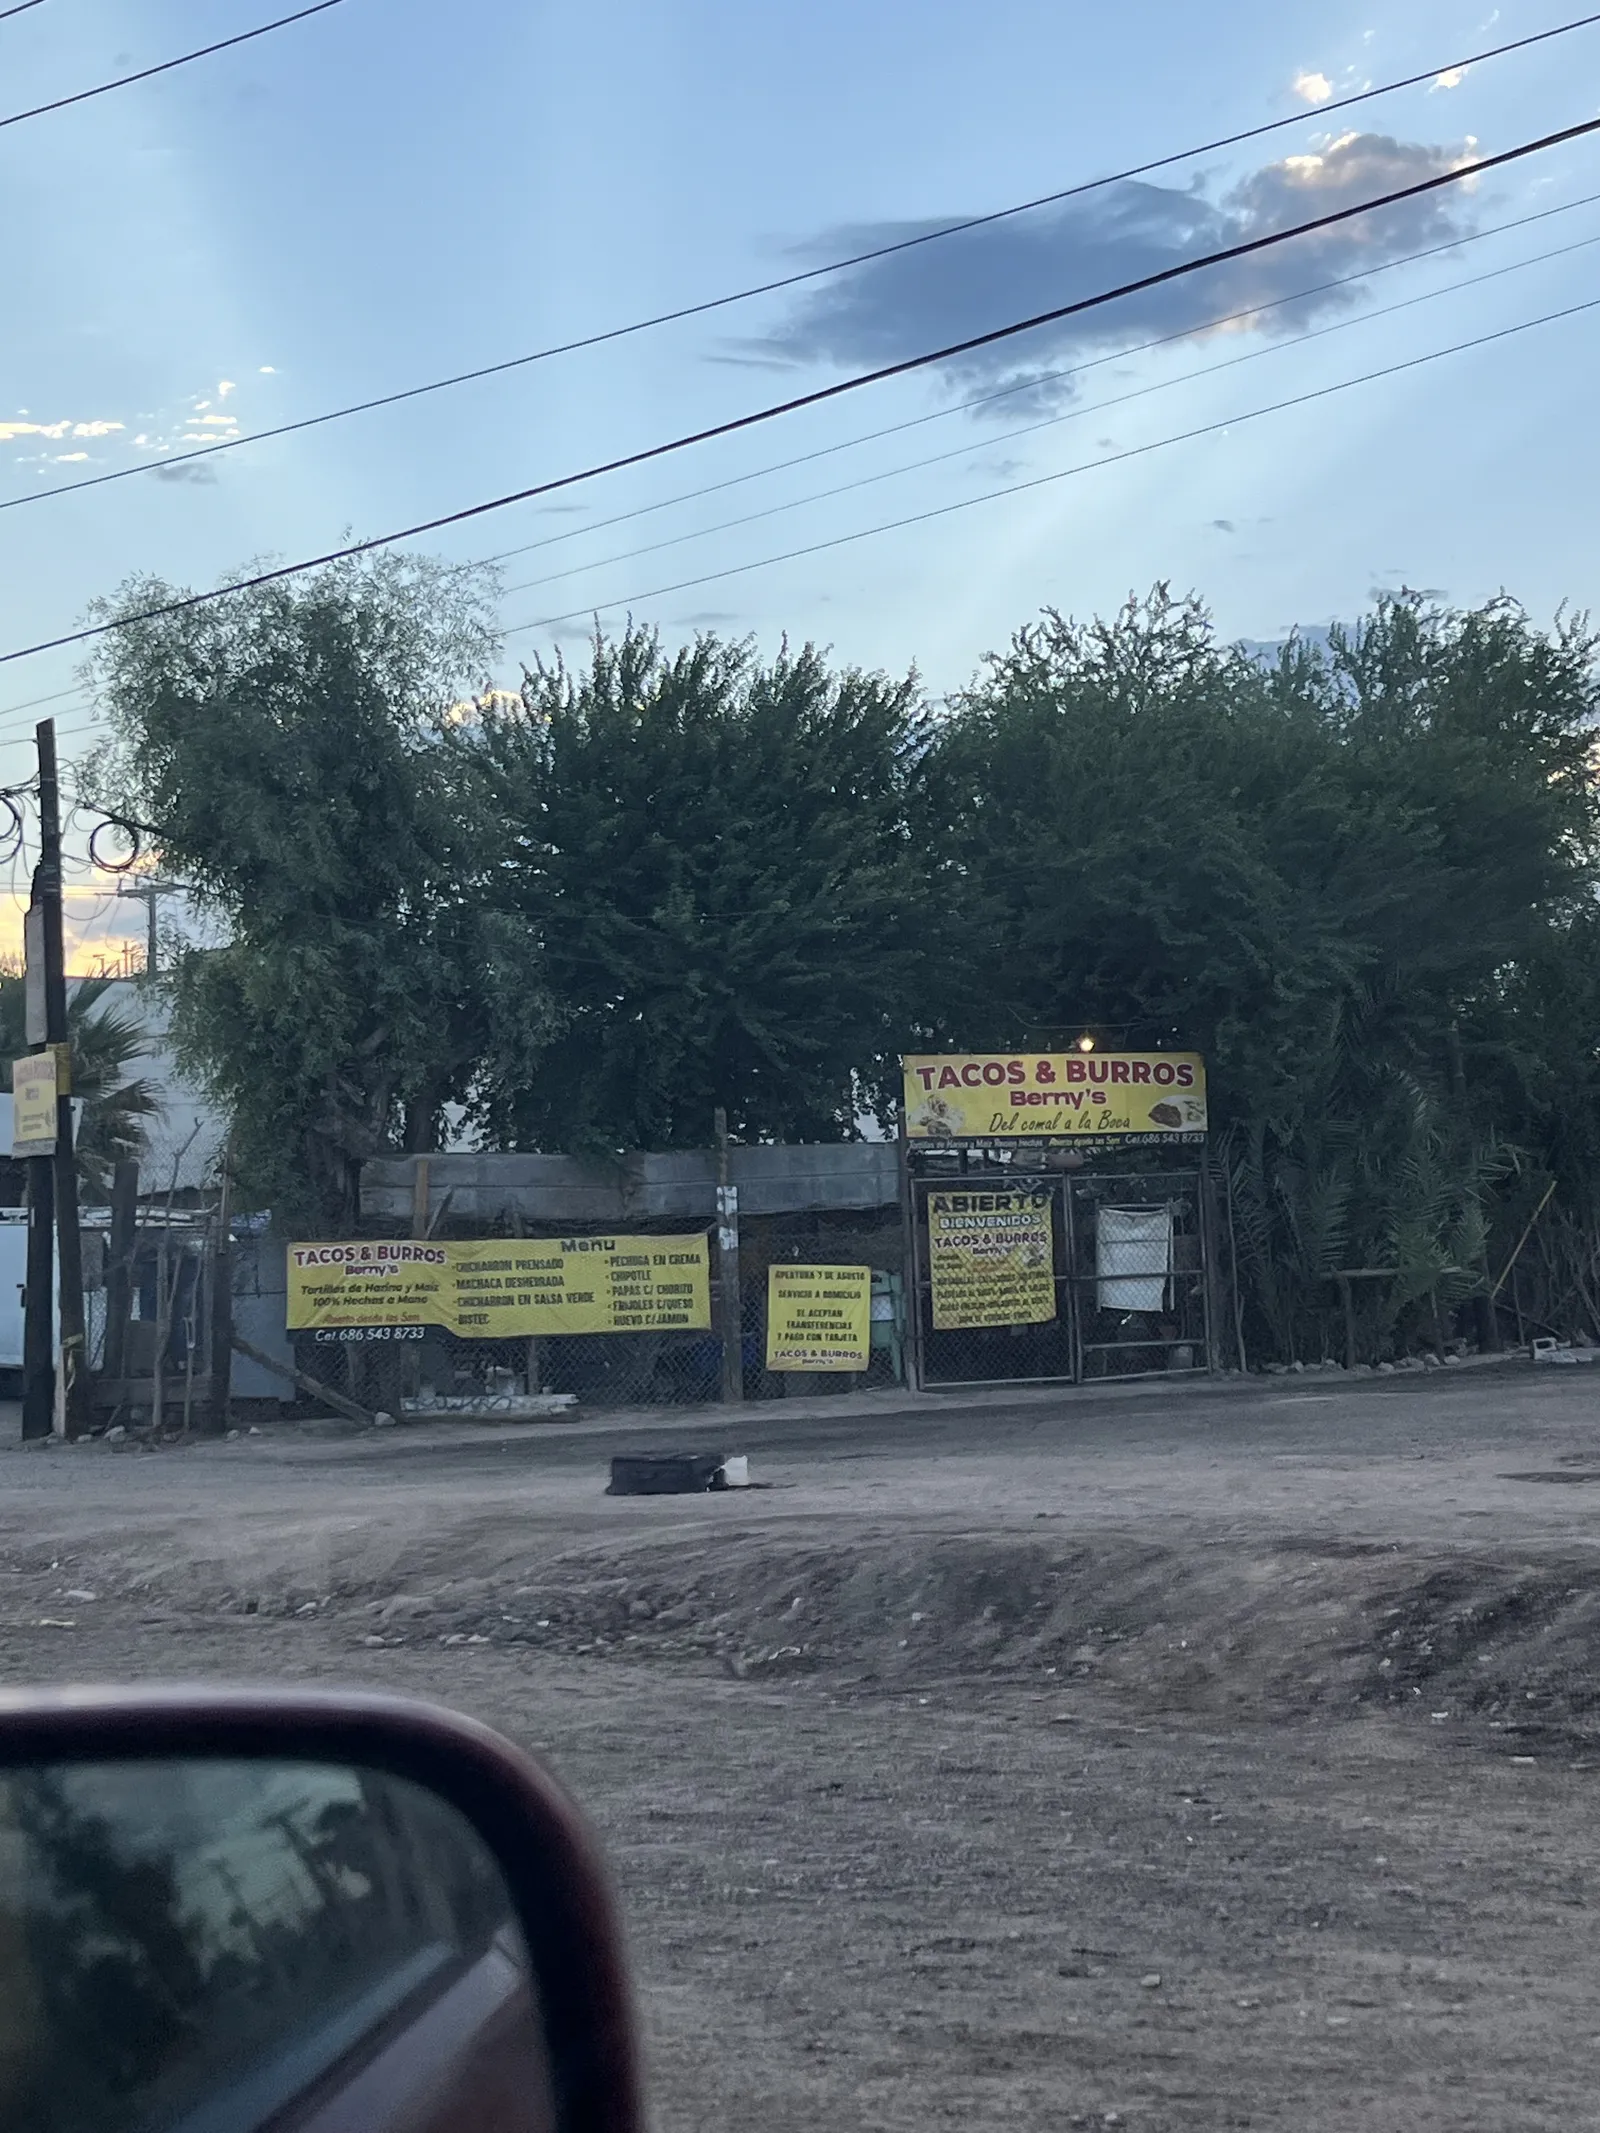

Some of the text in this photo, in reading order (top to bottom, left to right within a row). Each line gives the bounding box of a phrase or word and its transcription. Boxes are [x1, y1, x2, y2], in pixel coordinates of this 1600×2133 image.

[916, 1060, 1194, 1091] TACOS & BURROS
[1010, 1089, 1107, 1110] Berny's
[988, 1110, 1131, 1133] Del comal a la Boca
[1162, 1132, 1180, 1143] 543
[1181, 1132, 1205, 1143] 8733
[933, 1194, 1047, 1213] ABIERTO
[940, 1214, 1041, 1229] BIENVENIDOS
[561, 1239, 616, 1253] Menu
[935, 1231, 1047, 1248] TACOS & BURROS
[294, 1246, 446, 1266] TACOS & BURROS
[610, 1254, 701, 1267] PECHUGA EN CREMA
[345, 1264, 399, 1277] Berny's
[456, 1258, 564, 1272] CHICHARRON PRENSADO
[611, 1270, 652, 1282] CHIPOTLE
[775, 1271, 815, 1280] APERTURA
[825, 1271, 836, 1280] DE
[837, 1272, 865, 1280] AGOSTO
[301, 1283, 345, 1296] Tortillas
[349, 1283, 361, 1293] de
[365, 1281, 401, 1293] Harina
[405, 1284, 412, 1294] y
[456, 1276, 565, 1290] MACHACA DESHEBRADA
[613, 1285, 641, 1297] PAPAS
[778, 1290, 861, 1299] SERVICIO A DOMICILIO
[313, 1297, 340, 1307] 100%
[343, 1295, 384, 1306] Hechas
[397, 1295, 428, 1304] Mano
[457, 1291, 595, 1308] CHICHARRON EN SALSA VERDE
[613, 1300, 654, 1311] FRIJOLES
[458, 1313, 490, 1325] BISTEC
[613, 1314, 643, 1325] HUEVO
[797, 1309, 843, 1317] SE ACEPTAN
[786, 1320, 852, 1329] TRANSFERENCIAS
[366, 1327, 390, 1341] 543
[394, 1326, 425, 1340] 8733
[784, 1333, 805, 1341] PAGO
[806, 1333, 822, 1341] CON
[825, 1333, 858, 1342] TARJETA
[774, 1350, 808, 1358] TACOS
[820, 1350, 863, 1359] BURROS
